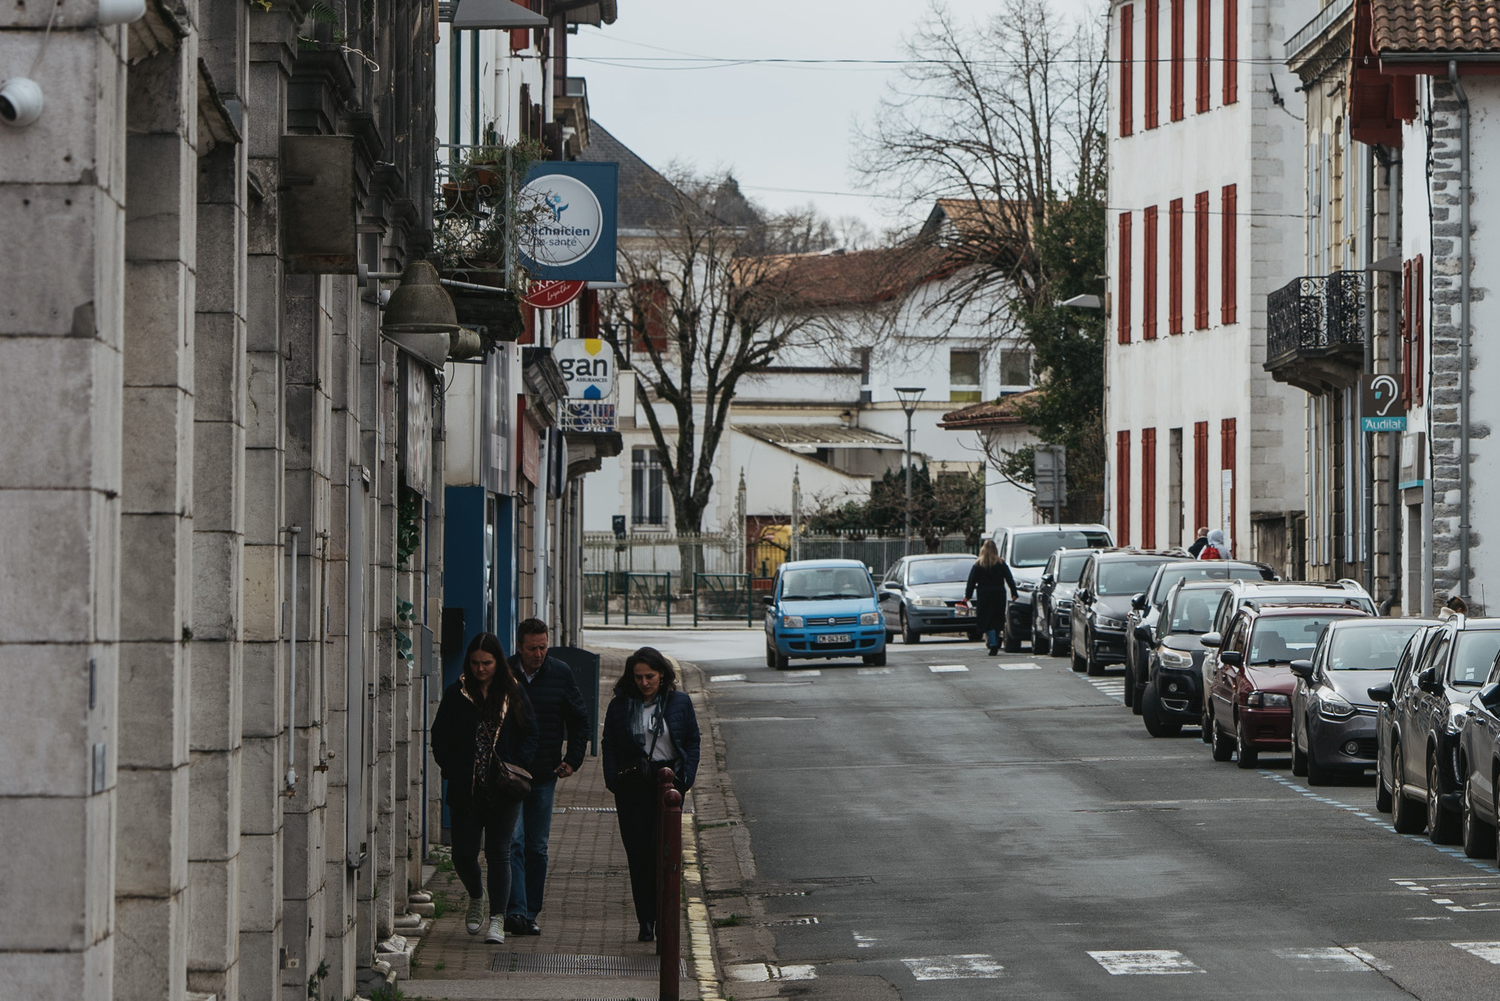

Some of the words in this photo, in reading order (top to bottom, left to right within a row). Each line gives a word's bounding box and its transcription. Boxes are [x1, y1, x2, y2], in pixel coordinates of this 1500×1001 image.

[522, 225, 590, 237] Technicien
[549, 237, 577, 247] santé
[559, 358, 608, 382] gan
